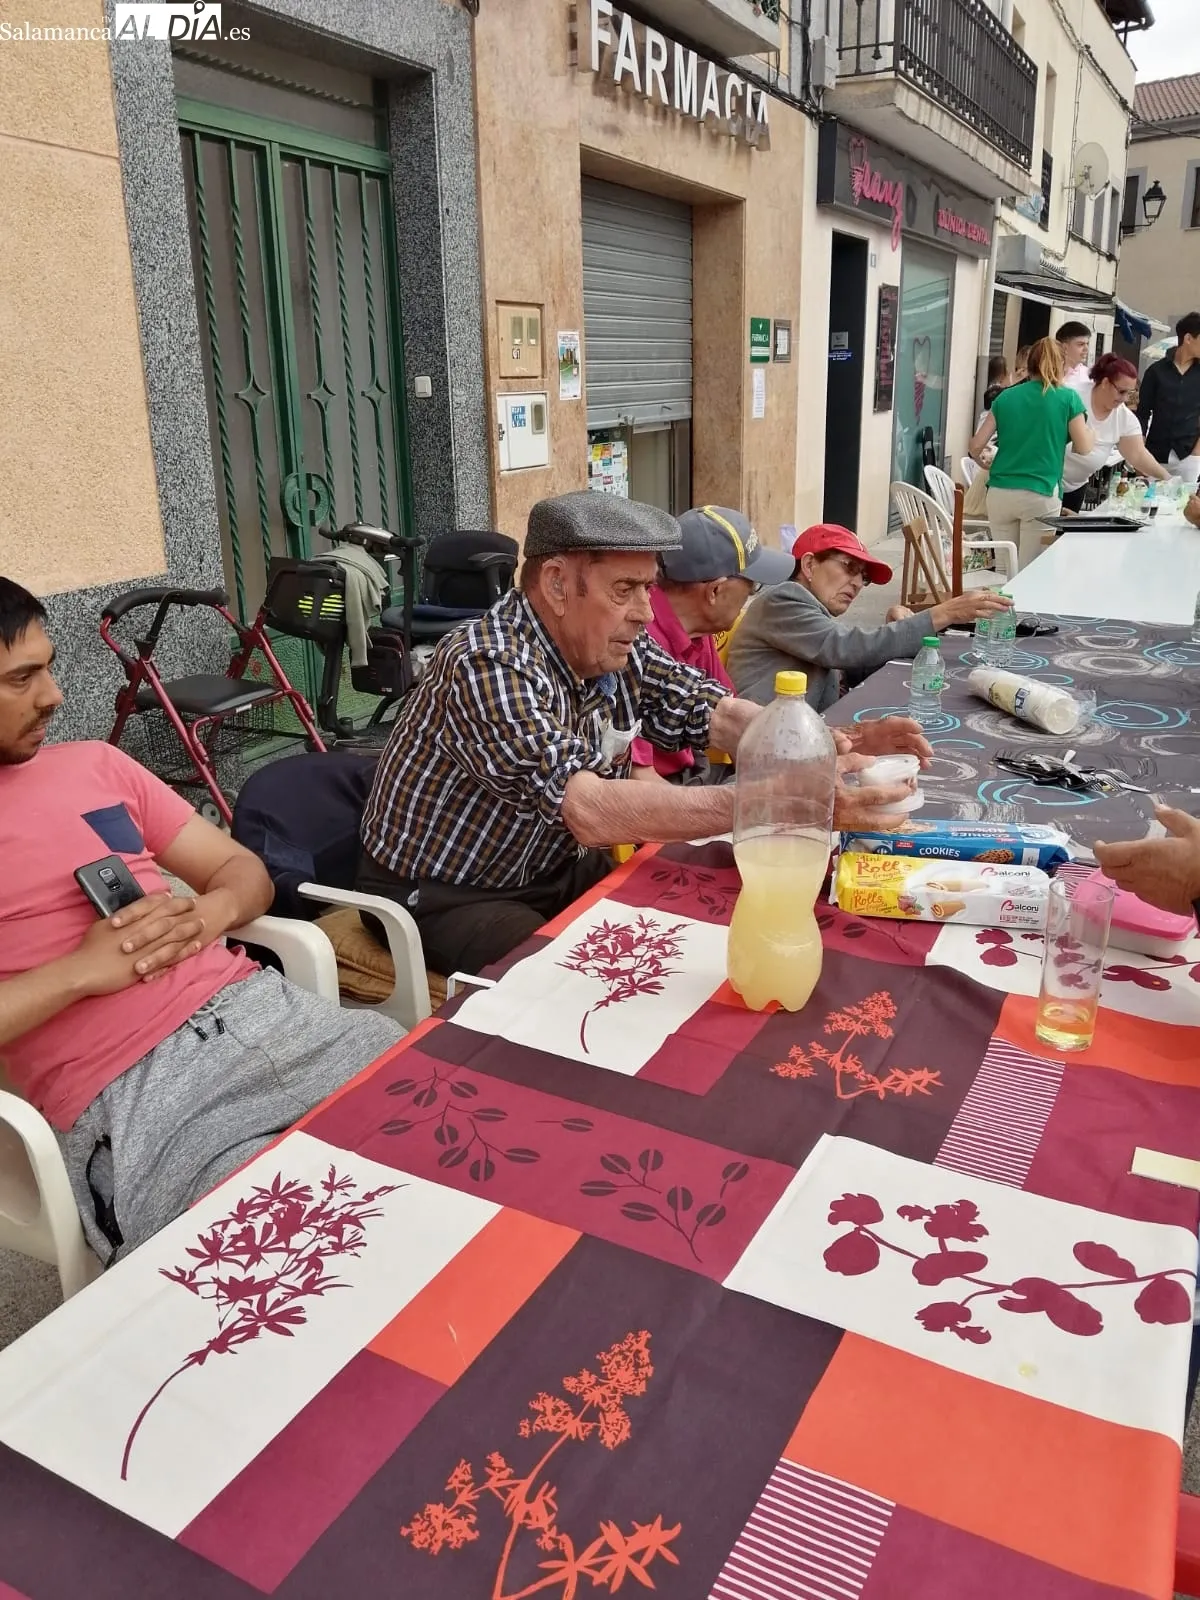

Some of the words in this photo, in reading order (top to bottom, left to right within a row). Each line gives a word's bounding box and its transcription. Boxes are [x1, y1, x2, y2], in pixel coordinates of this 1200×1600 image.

[590, 0, 771, 143] FARMACIA
[919, 846, 961, 858] COOKIES
[1000, 899, 1039, 912] Balconi
